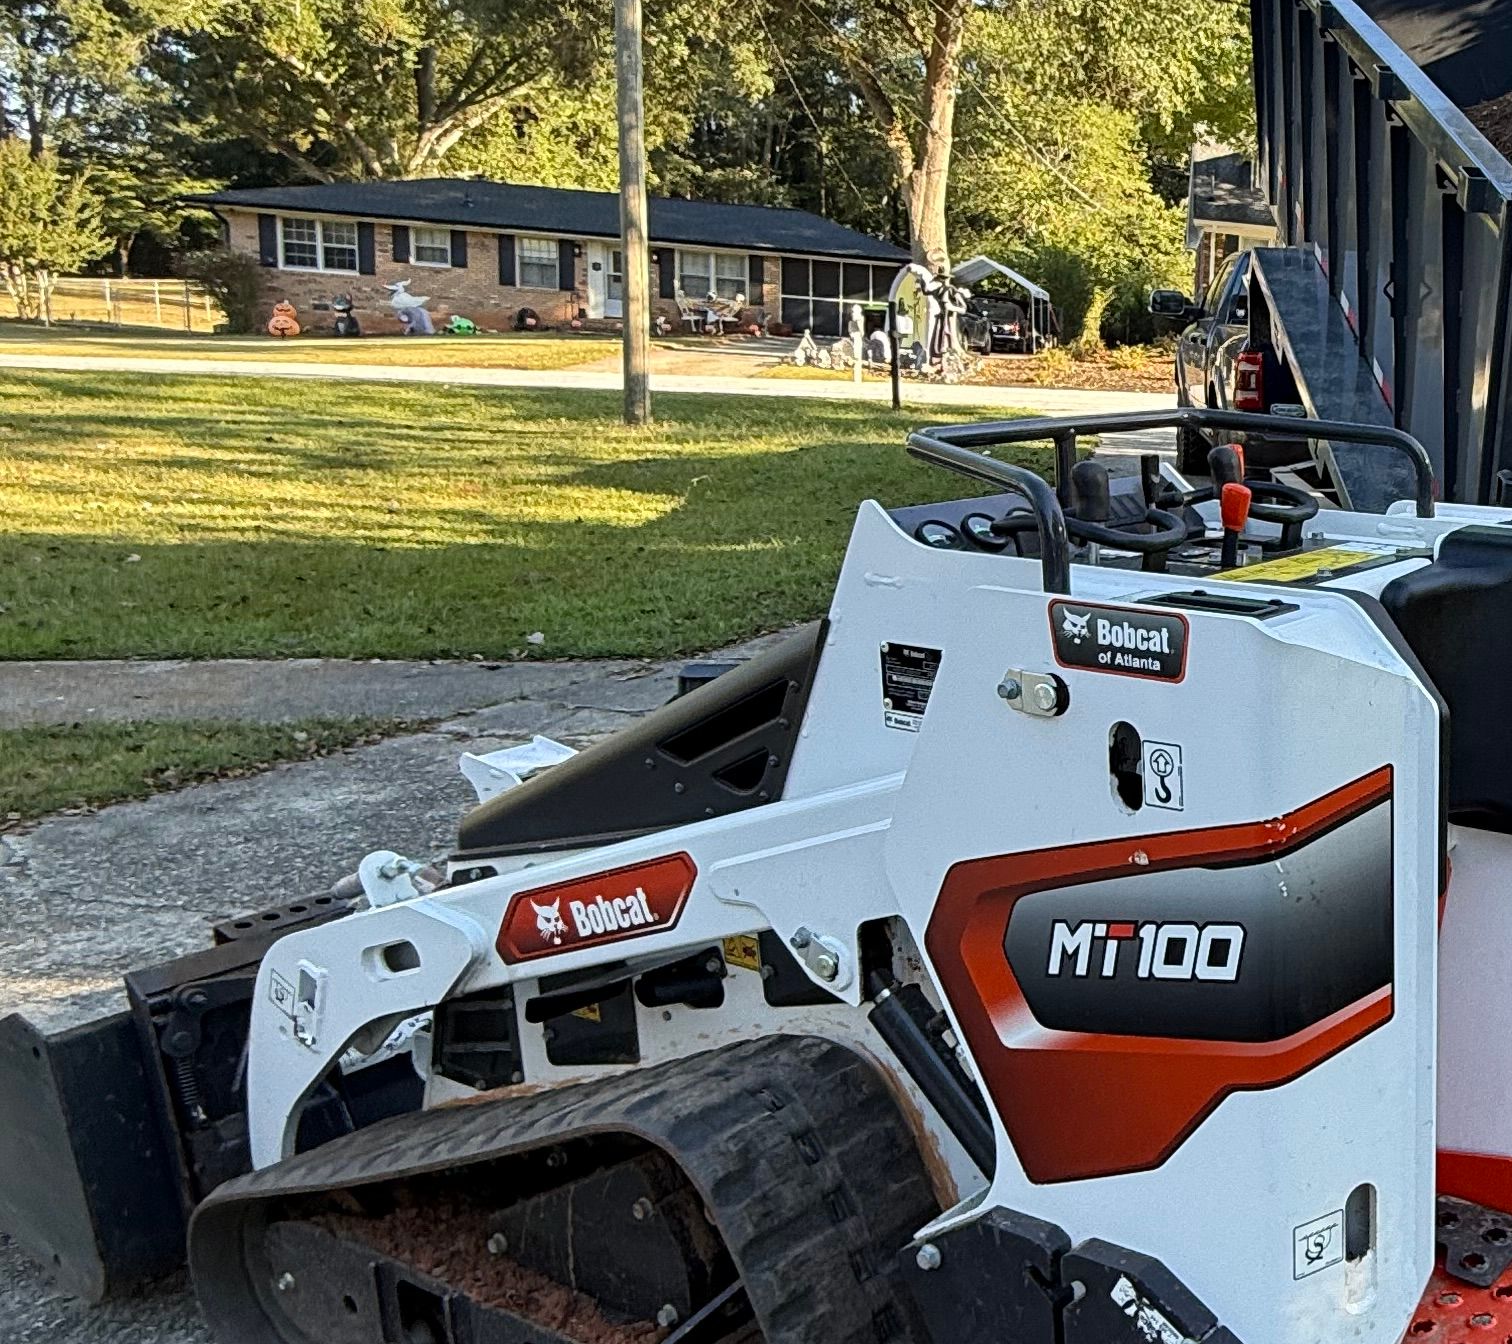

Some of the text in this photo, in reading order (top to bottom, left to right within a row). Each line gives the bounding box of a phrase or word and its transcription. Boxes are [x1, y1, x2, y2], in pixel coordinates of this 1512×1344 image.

[1097, 618, 1169, 653] Bobcat
[1098, 650, 1160, 671] of Atlanta
[569, 887, 654, 936] Bobcat
[1048, 922, 1244, 981] MT100
